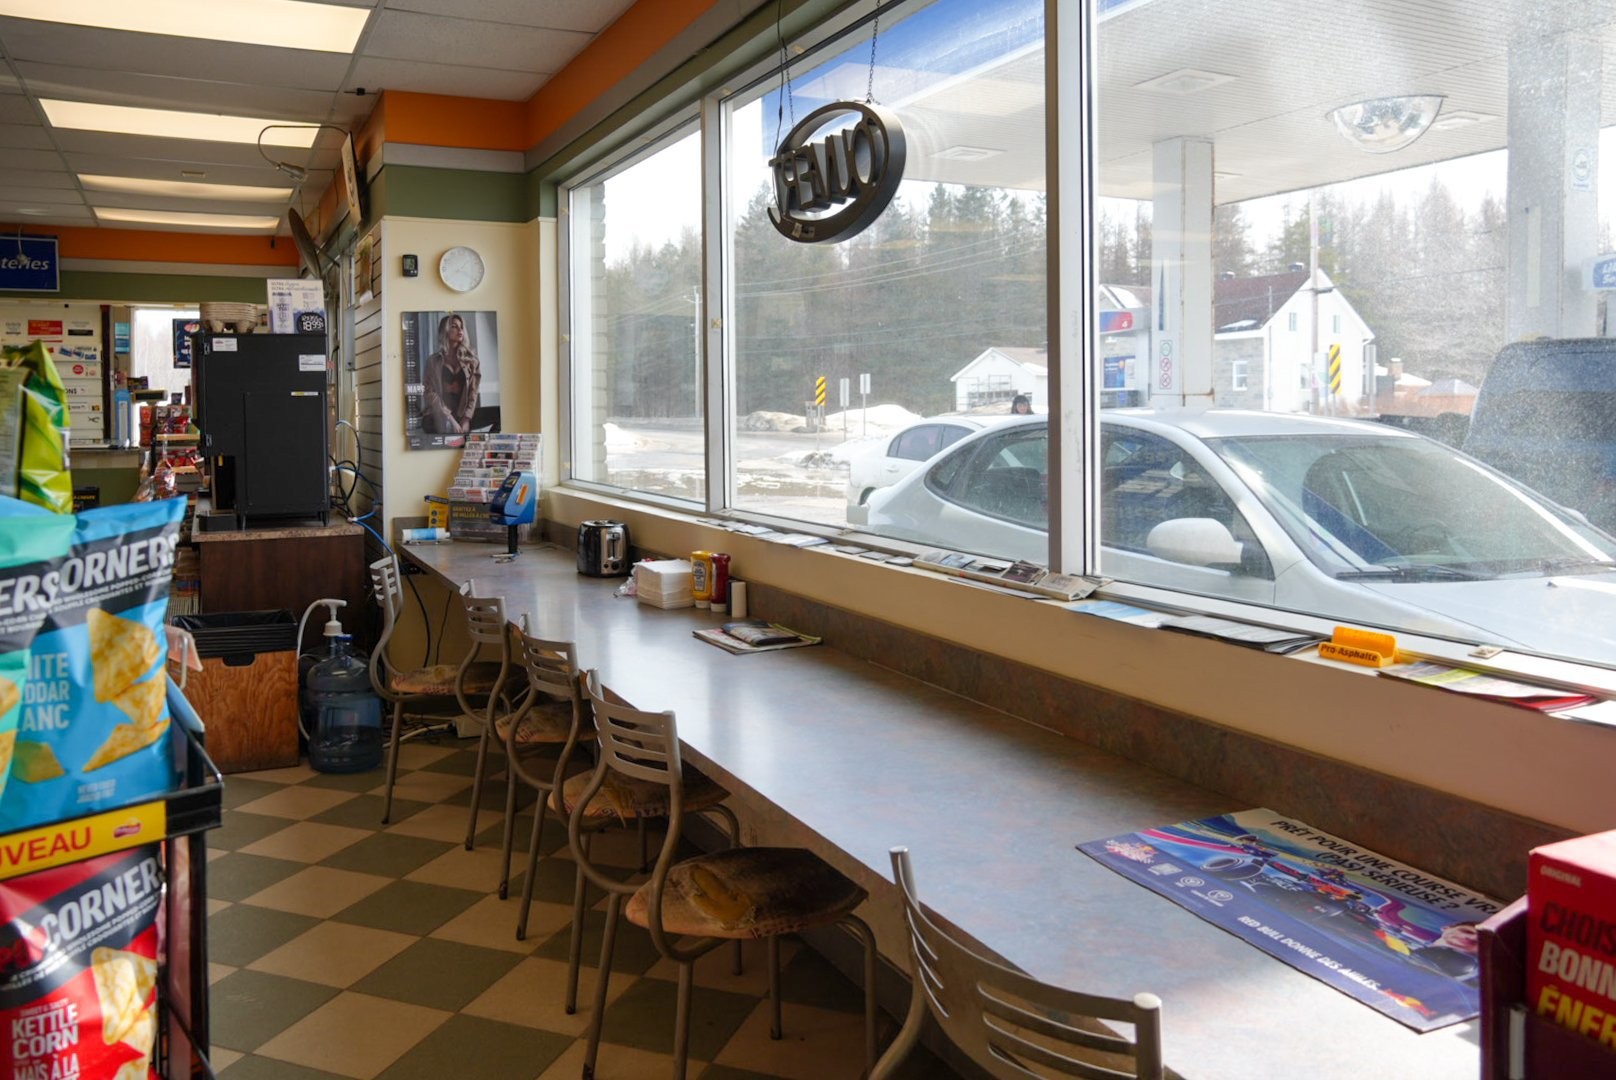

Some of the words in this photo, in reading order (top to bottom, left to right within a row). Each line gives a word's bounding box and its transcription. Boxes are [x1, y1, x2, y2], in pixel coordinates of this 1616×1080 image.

[0, 256, 50, 270] teies
[1307, 836, 1357, 855] POUR
[1354, 853, 1394, 871] UNE
[1391, 869, 1468, 898] COURSE
[1316, 851, 1365, 872] (PAS)
[1237, 916, 1261, 928] RED
[1256, 926, 1285, 940] BULL
[12, 1003, 78, 1039] KETTLE
[13, 1023, 79, 1060] CORN
